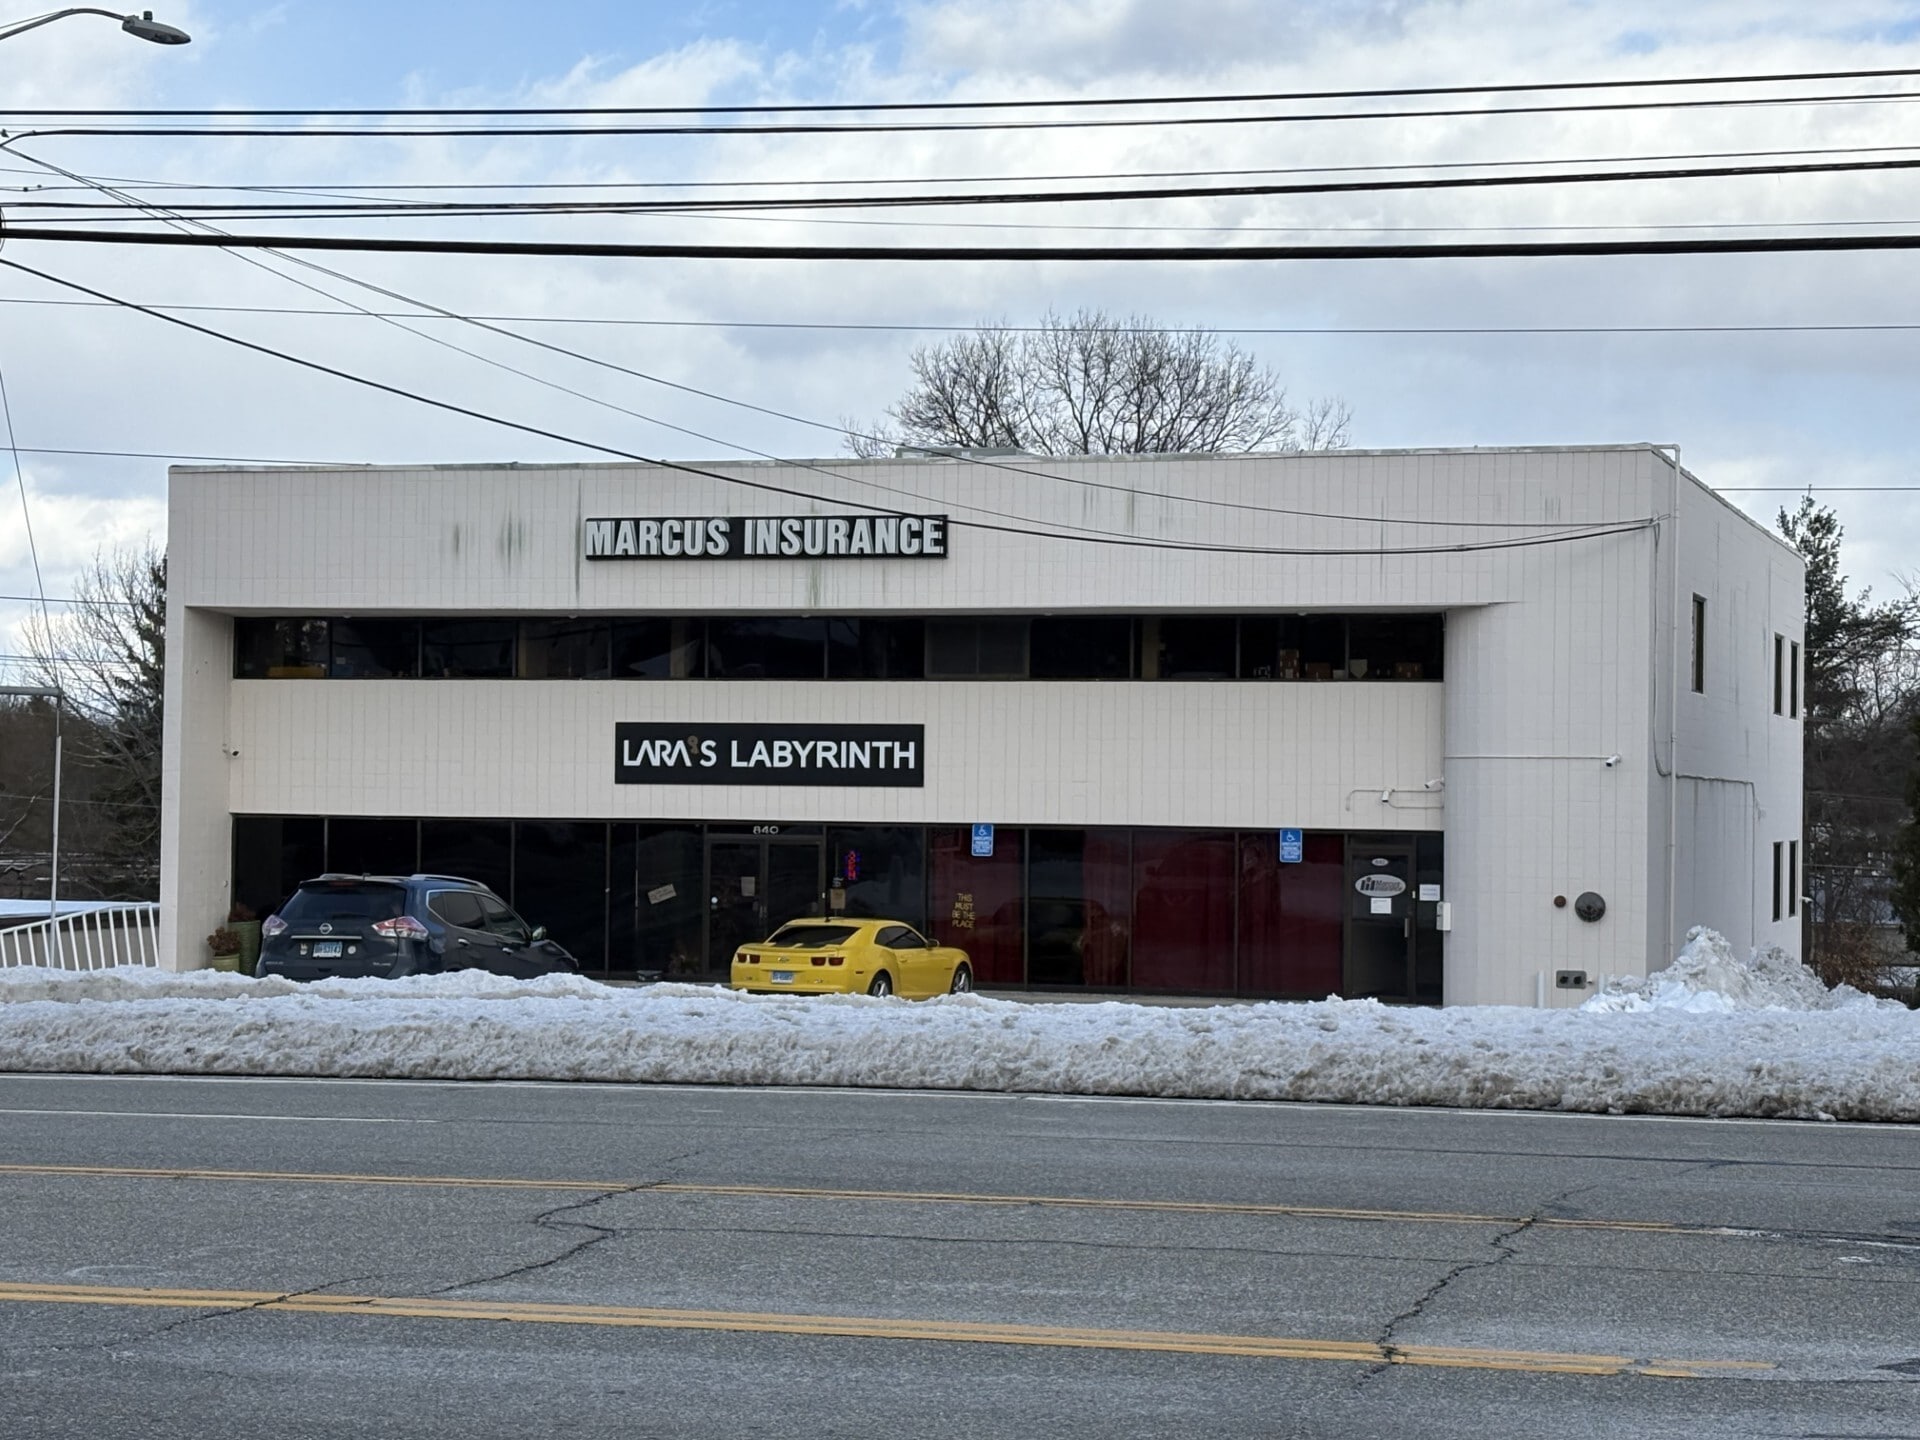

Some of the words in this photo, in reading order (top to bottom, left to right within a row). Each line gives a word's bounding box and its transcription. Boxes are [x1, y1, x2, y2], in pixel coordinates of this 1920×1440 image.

[586, 519, 730, 556] MARCUS
[743, 517, 944, 555] INSURANCE
[731, 740, 915, 769] LABYRINTH
[753, 825, 779, 835] 840
[957, 892, 973, 902] THIS
[955, 902, 974, 911] MUST
[952, 910, 961, 919] BE
[952, 919, 975, 929] PLACE
